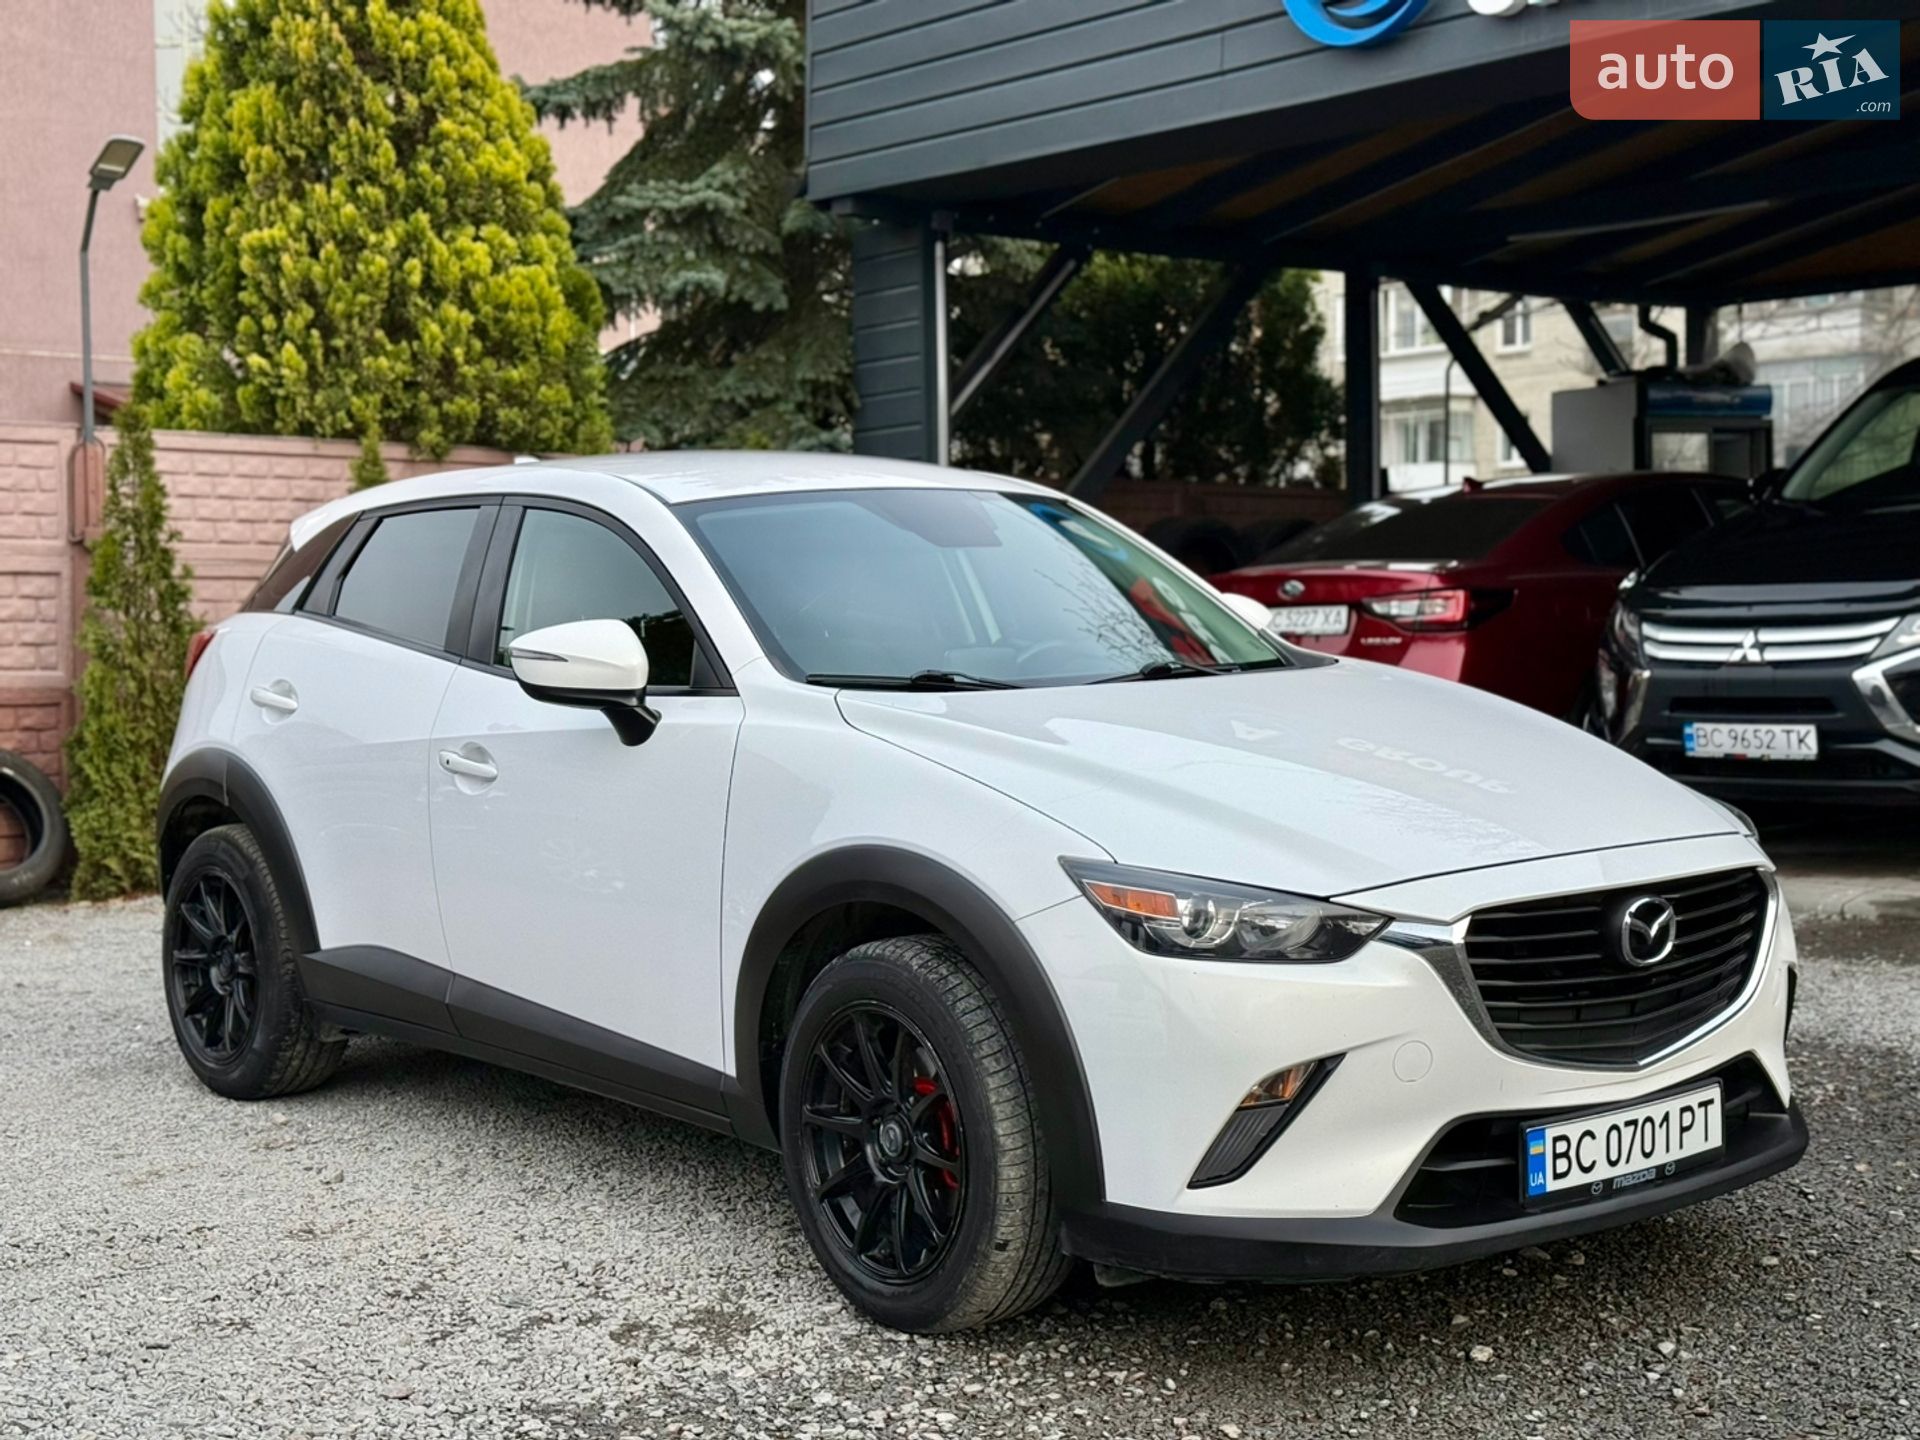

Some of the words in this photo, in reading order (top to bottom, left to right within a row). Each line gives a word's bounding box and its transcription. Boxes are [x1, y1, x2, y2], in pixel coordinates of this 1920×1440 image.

[1695, 727, 1723, 748] BC
[1727, 728, 1776, 750] 9652
[1781, 729, 1812, 751] TK
[1552, 1129, 1598, 1181] BC
[1605, 1109, 1671, 1168] 0701
[1678, 1097, 1715, 1151] PT
[1530, 1171, 1545, 1187] UA
